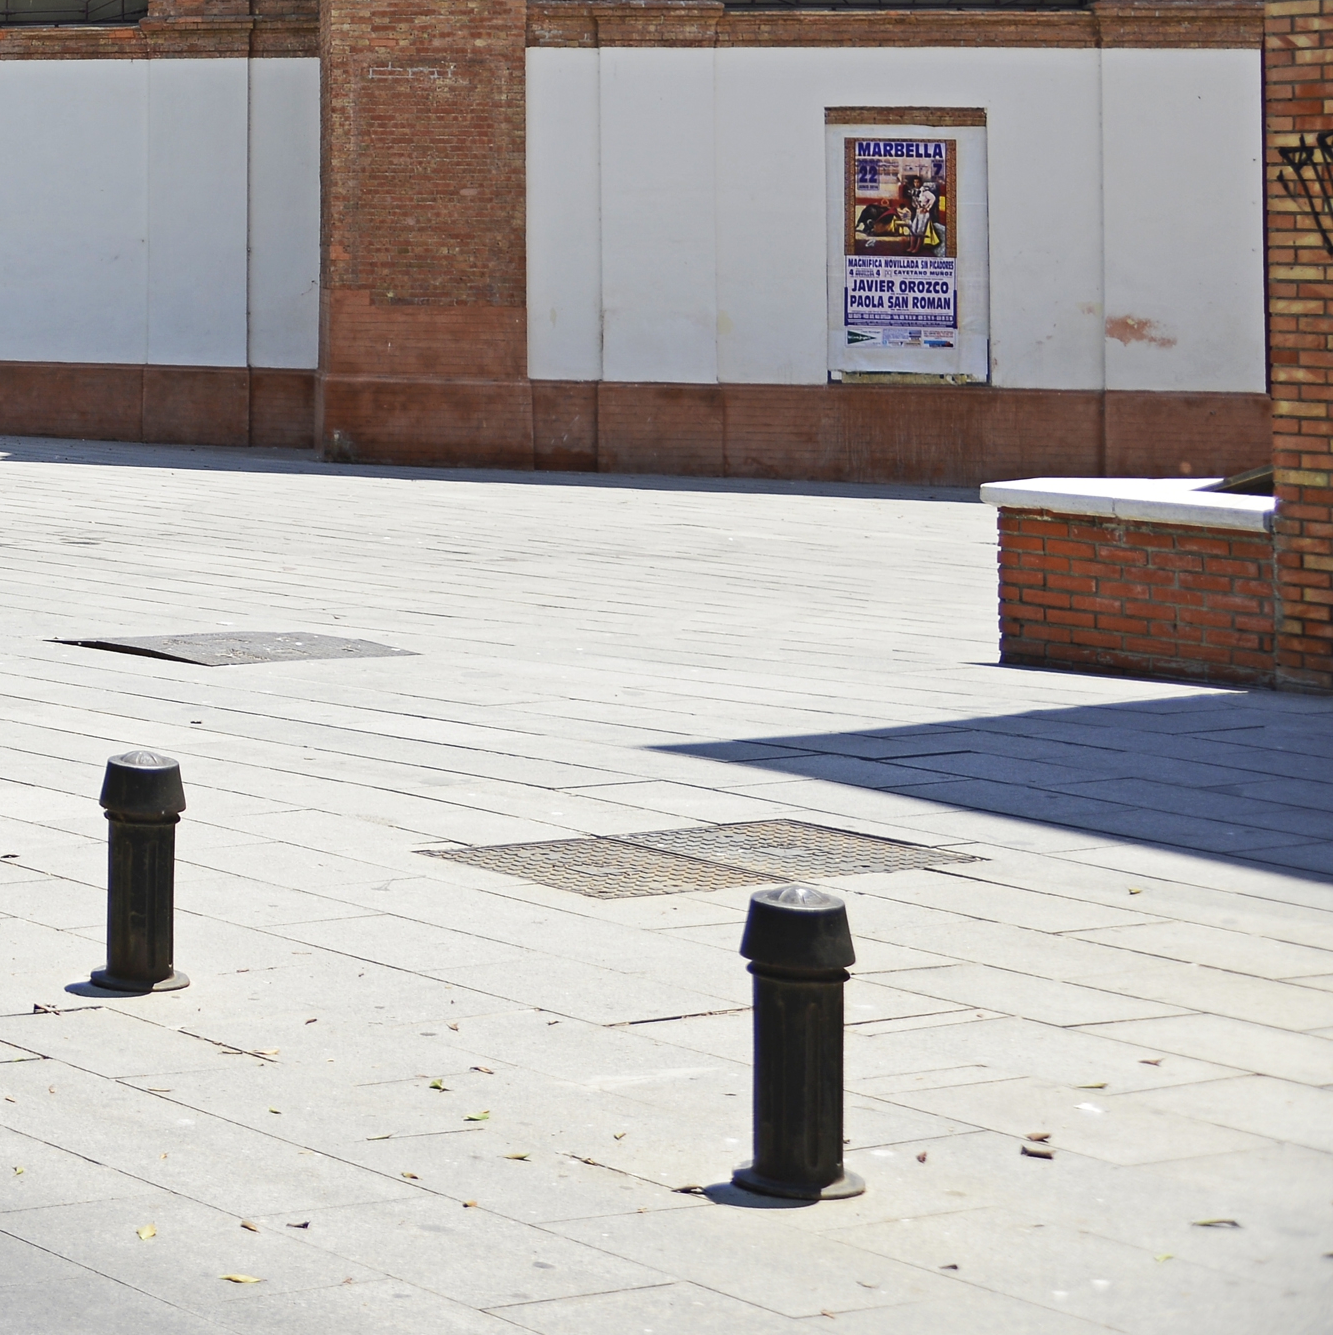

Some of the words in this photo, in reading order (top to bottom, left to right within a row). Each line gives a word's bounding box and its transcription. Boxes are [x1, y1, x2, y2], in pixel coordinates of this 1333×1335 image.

[857, 141, 943, 159] MARBELLA
[859, 165, 878, 183] 22
[932, 163, 942, 176] 7
[884, 259, 919, 269] NOVILLADA
[929, 260, 954, 271] PICADORES
[851, 279, 895, 293] JAVIER
[899, 280, 950, 294] OROZCO
[849, 294, 884, 308] PAOLA
[887, 295, 909, 308] SAN
[912, 296, 951, 310] ROMAN
